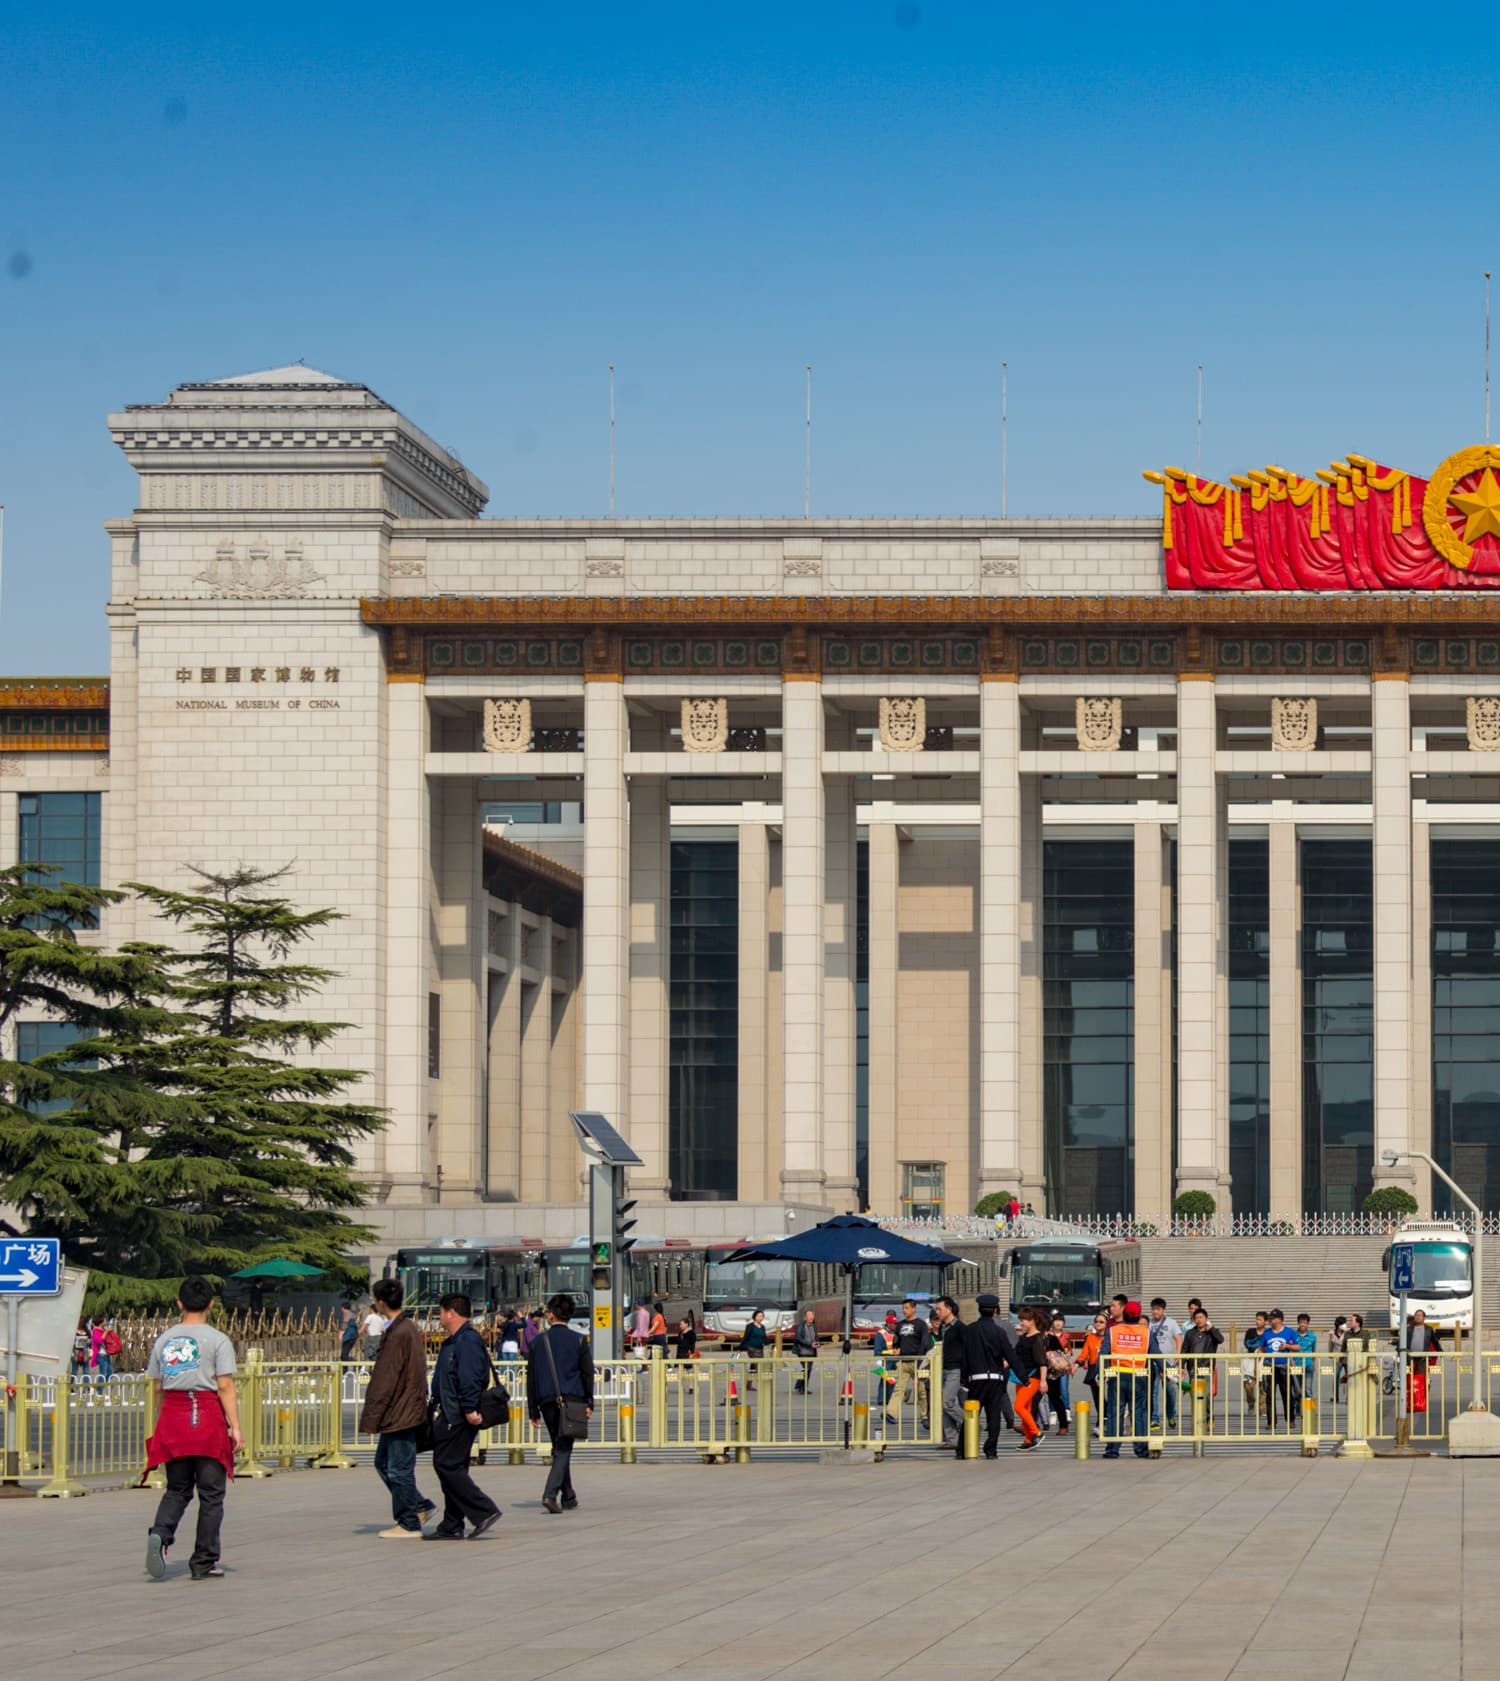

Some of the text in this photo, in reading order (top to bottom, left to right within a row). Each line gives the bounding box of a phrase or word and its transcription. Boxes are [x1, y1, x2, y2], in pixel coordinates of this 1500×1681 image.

[176, 666, 341, 684] 中国国家博物馆
[176, 700, 341, 710] NATIONAL MUSEUM OF CHINA
[0, 1244, 50, 1265] 广场
